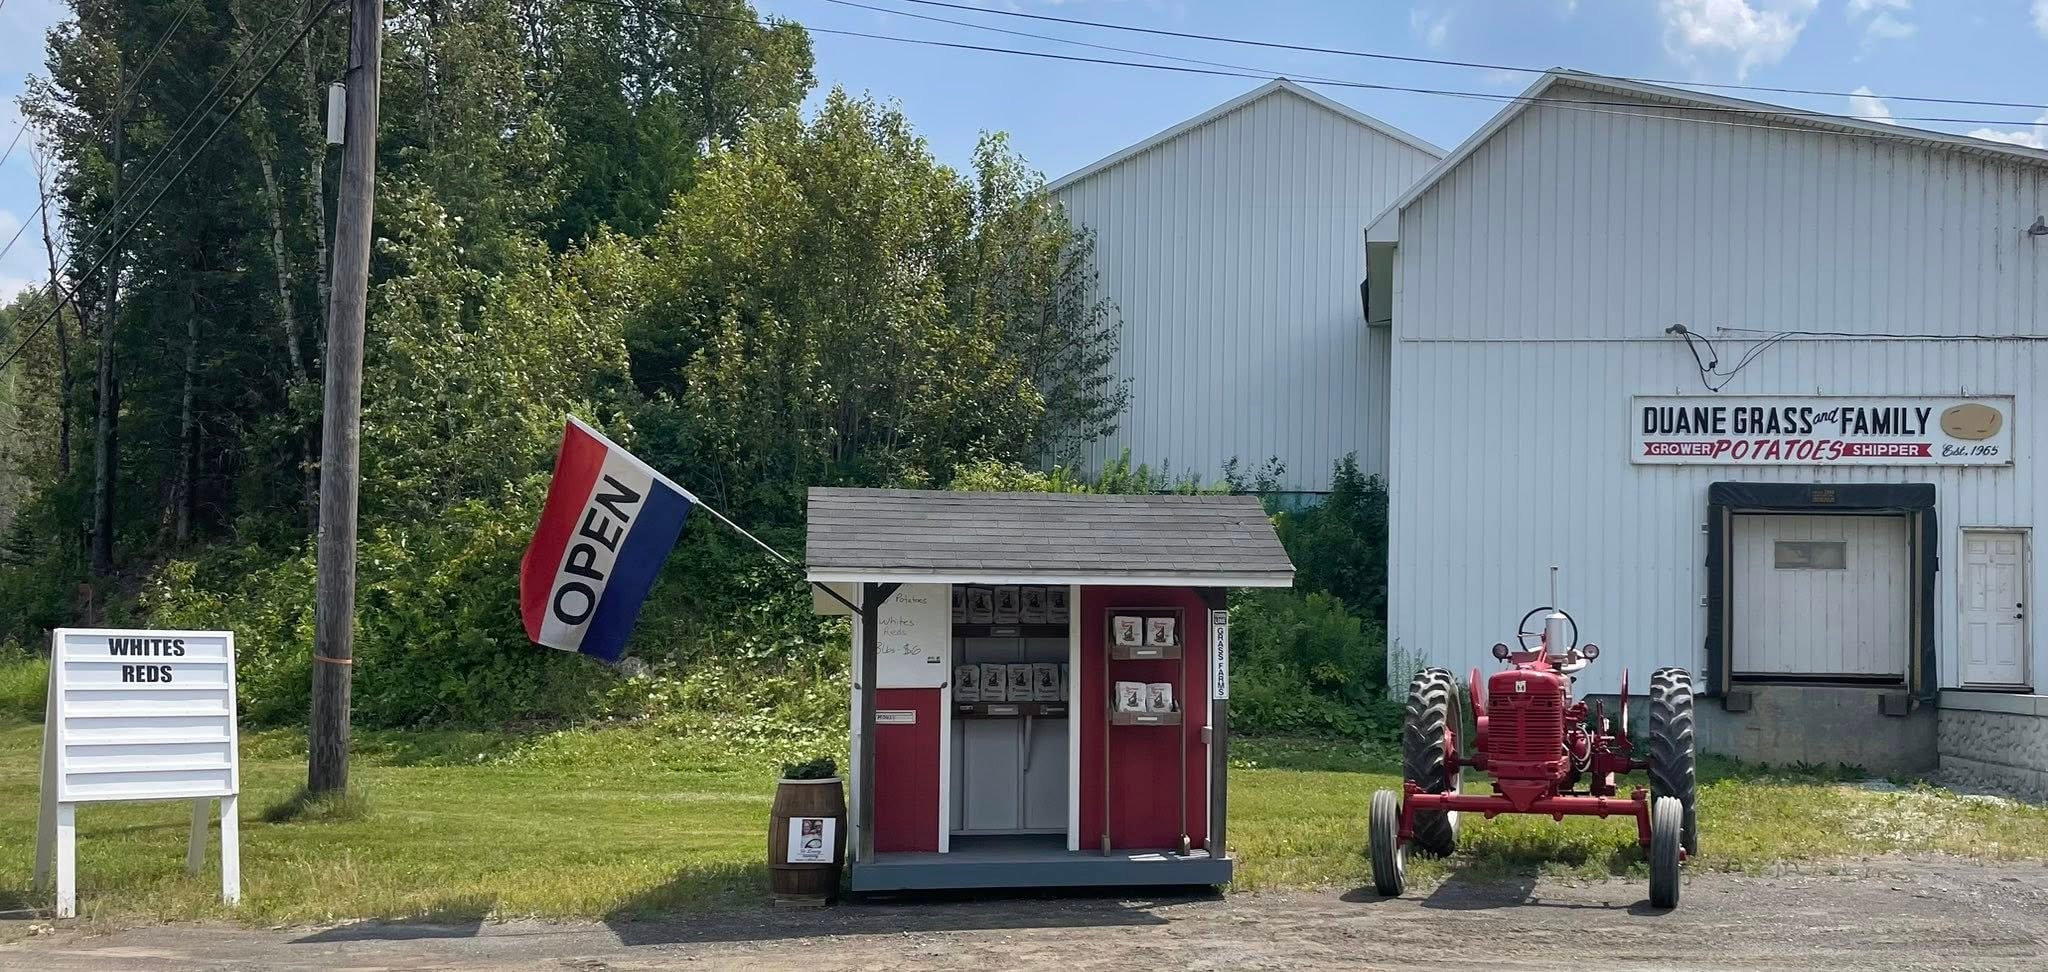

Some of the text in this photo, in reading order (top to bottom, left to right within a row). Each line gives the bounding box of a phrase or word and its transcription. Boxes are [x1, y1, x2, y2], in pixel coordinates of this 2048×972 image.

[1642, 406, 1932, 436] DUANE GRASS and FAMILY
[1650, 439, 1920, 461] GROWER POTATOES SHIPPER
[1942, 444, 1999, 457] Est. 1965
[553, 474, 641, 626] OPEN
[108, 638, 185, 657] WHITES
[122, 665, 173, 683] REDS
[1217, 662, 1225, 696] FARMS
